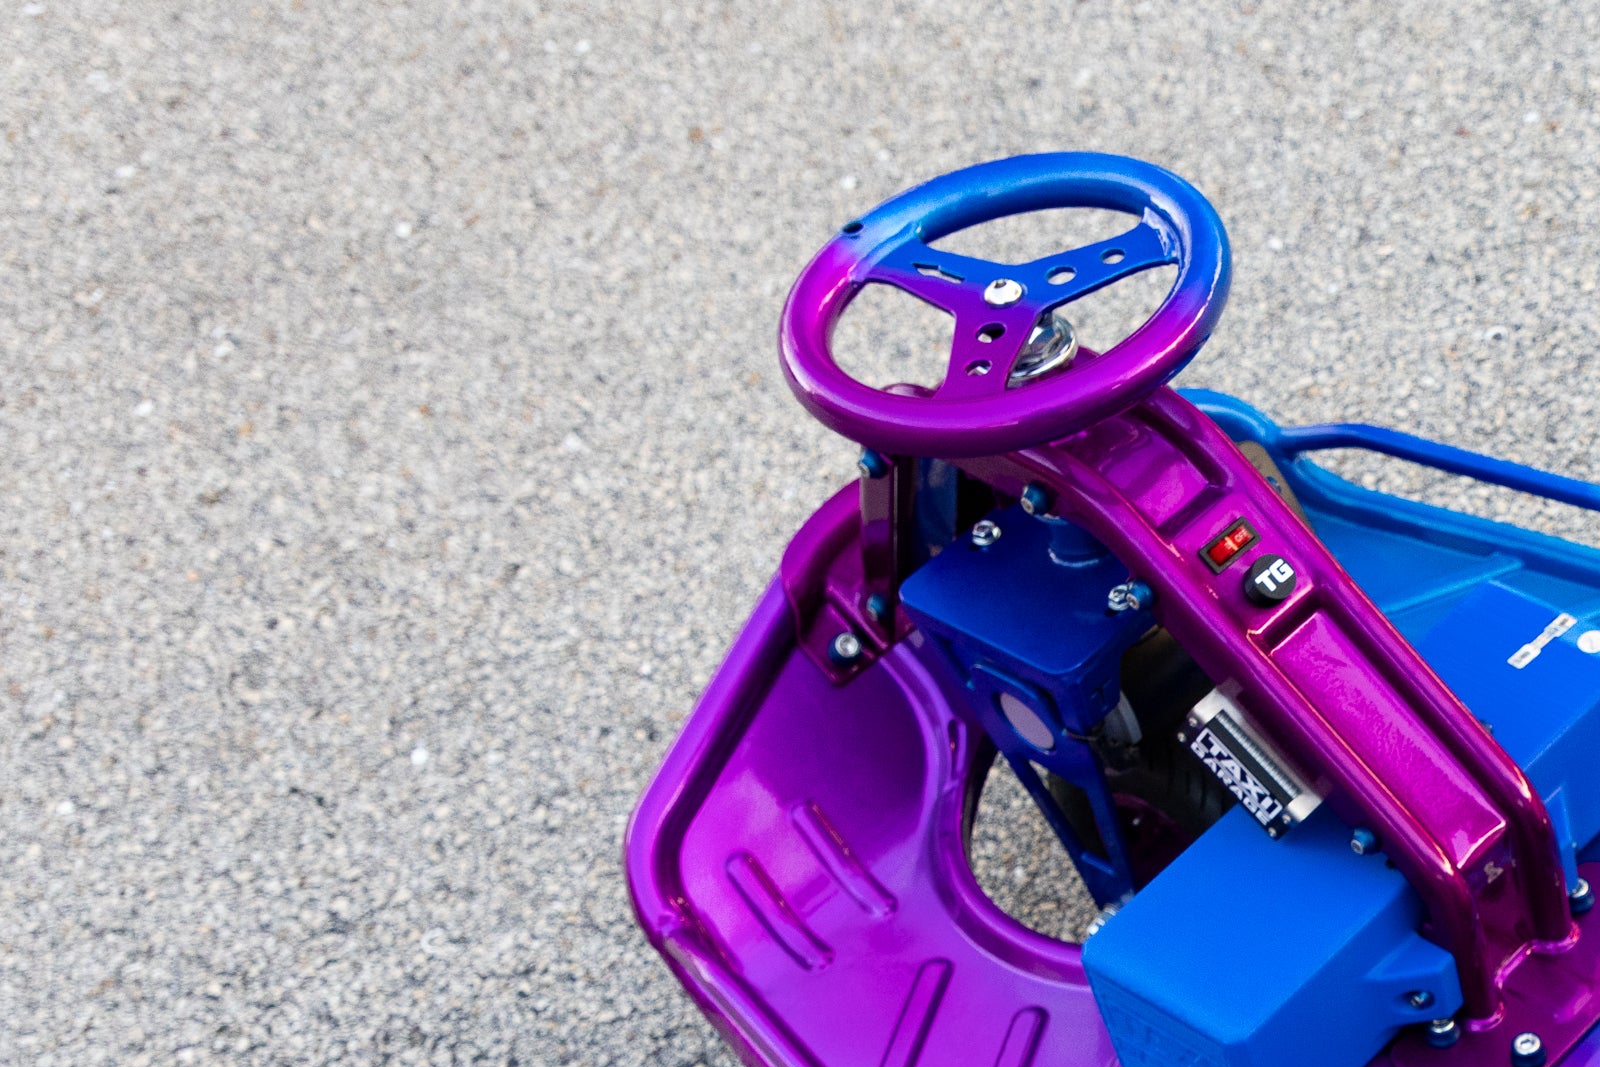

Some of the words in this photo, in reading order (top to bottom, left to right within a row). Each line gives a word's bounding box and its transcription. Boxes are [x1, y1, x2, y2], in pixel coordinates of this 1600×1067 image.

[1254, 558, 1295, 592] TG
[1190, 741, 1271, 826] GARAGE
[1205, 733, 1278, 813] TAXI
